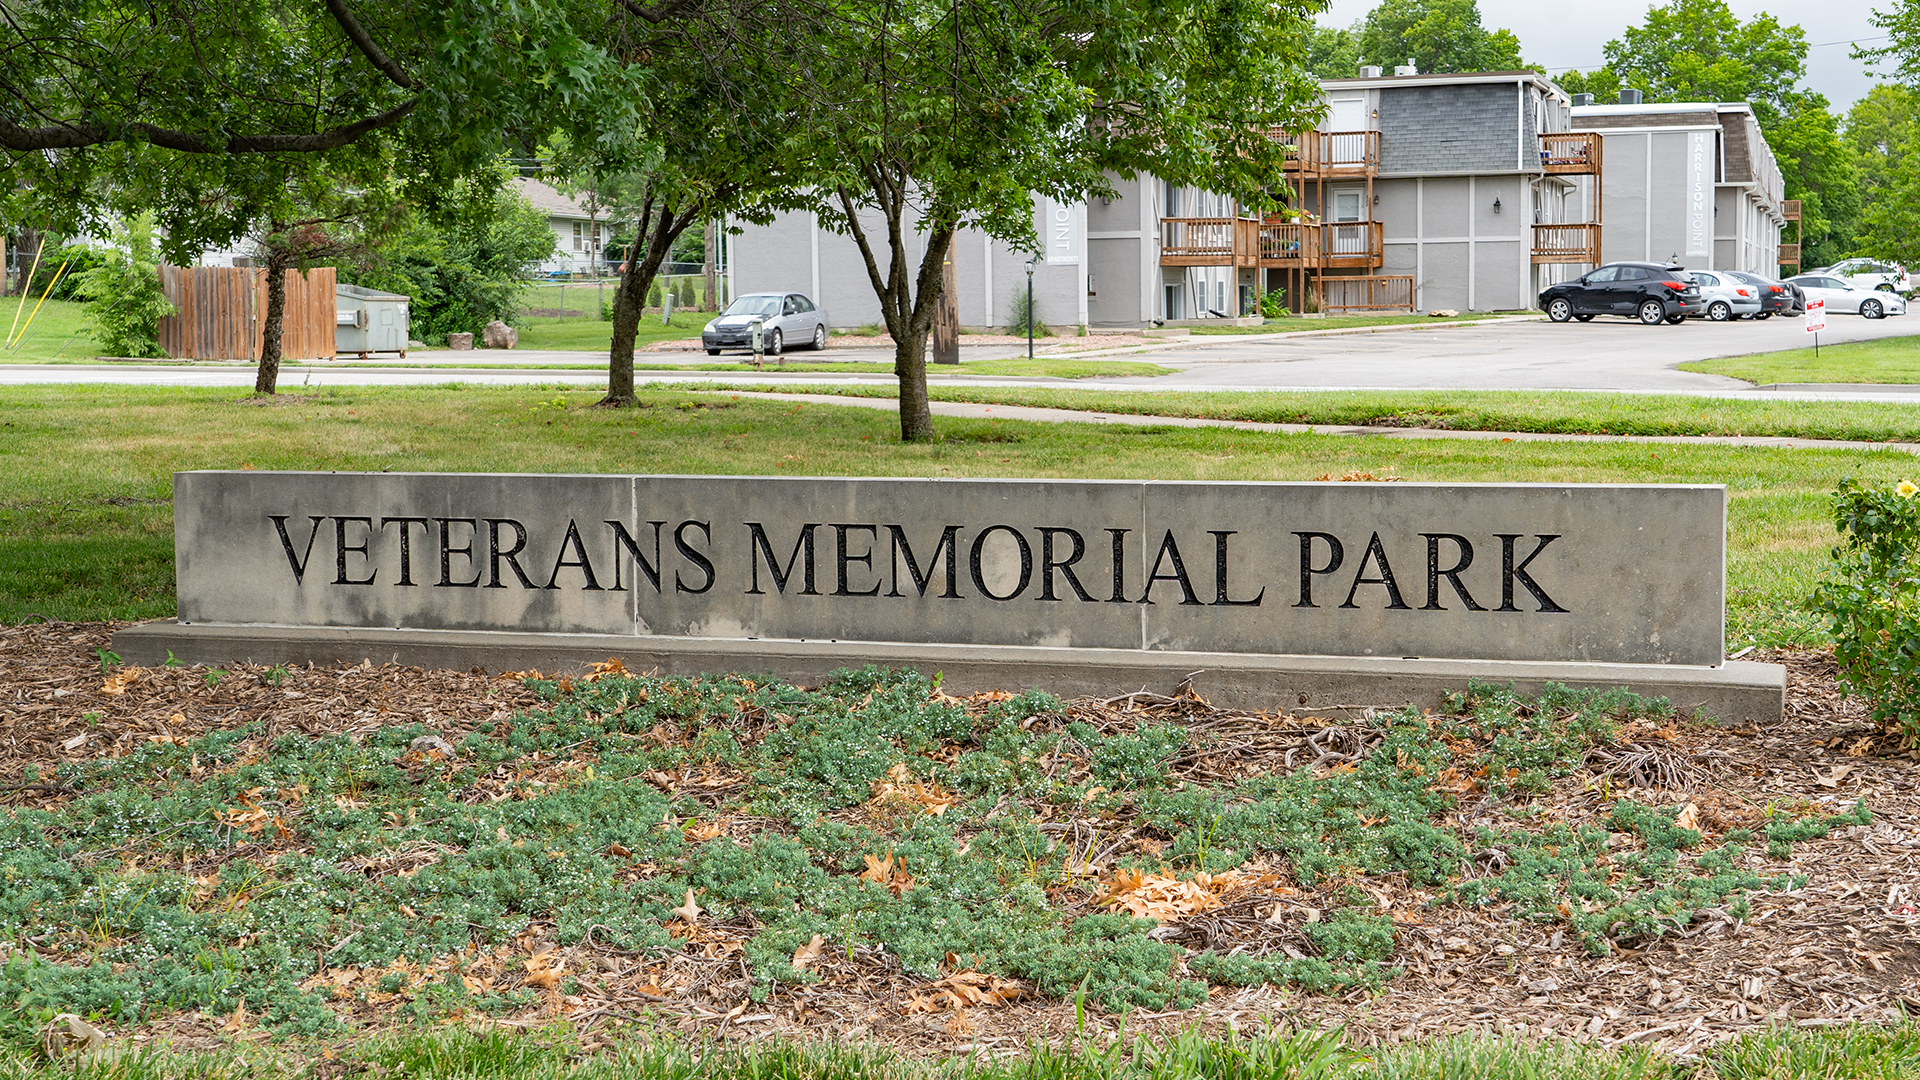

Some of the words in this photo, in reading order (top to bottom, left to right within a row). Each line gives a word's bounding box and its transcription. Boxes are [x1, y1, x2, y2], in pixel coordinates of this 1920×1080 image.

[1693, 133, 1704, 211] HARRISON
[1055, 202, 1070, 251] OINT
[1692, 213, 1703, 248] POINT
[267, 515, 715, 594] VETERANS
[744, 522, 1264, 605] MEMORIAL
[1291, 531, 1569, 613] PARK
